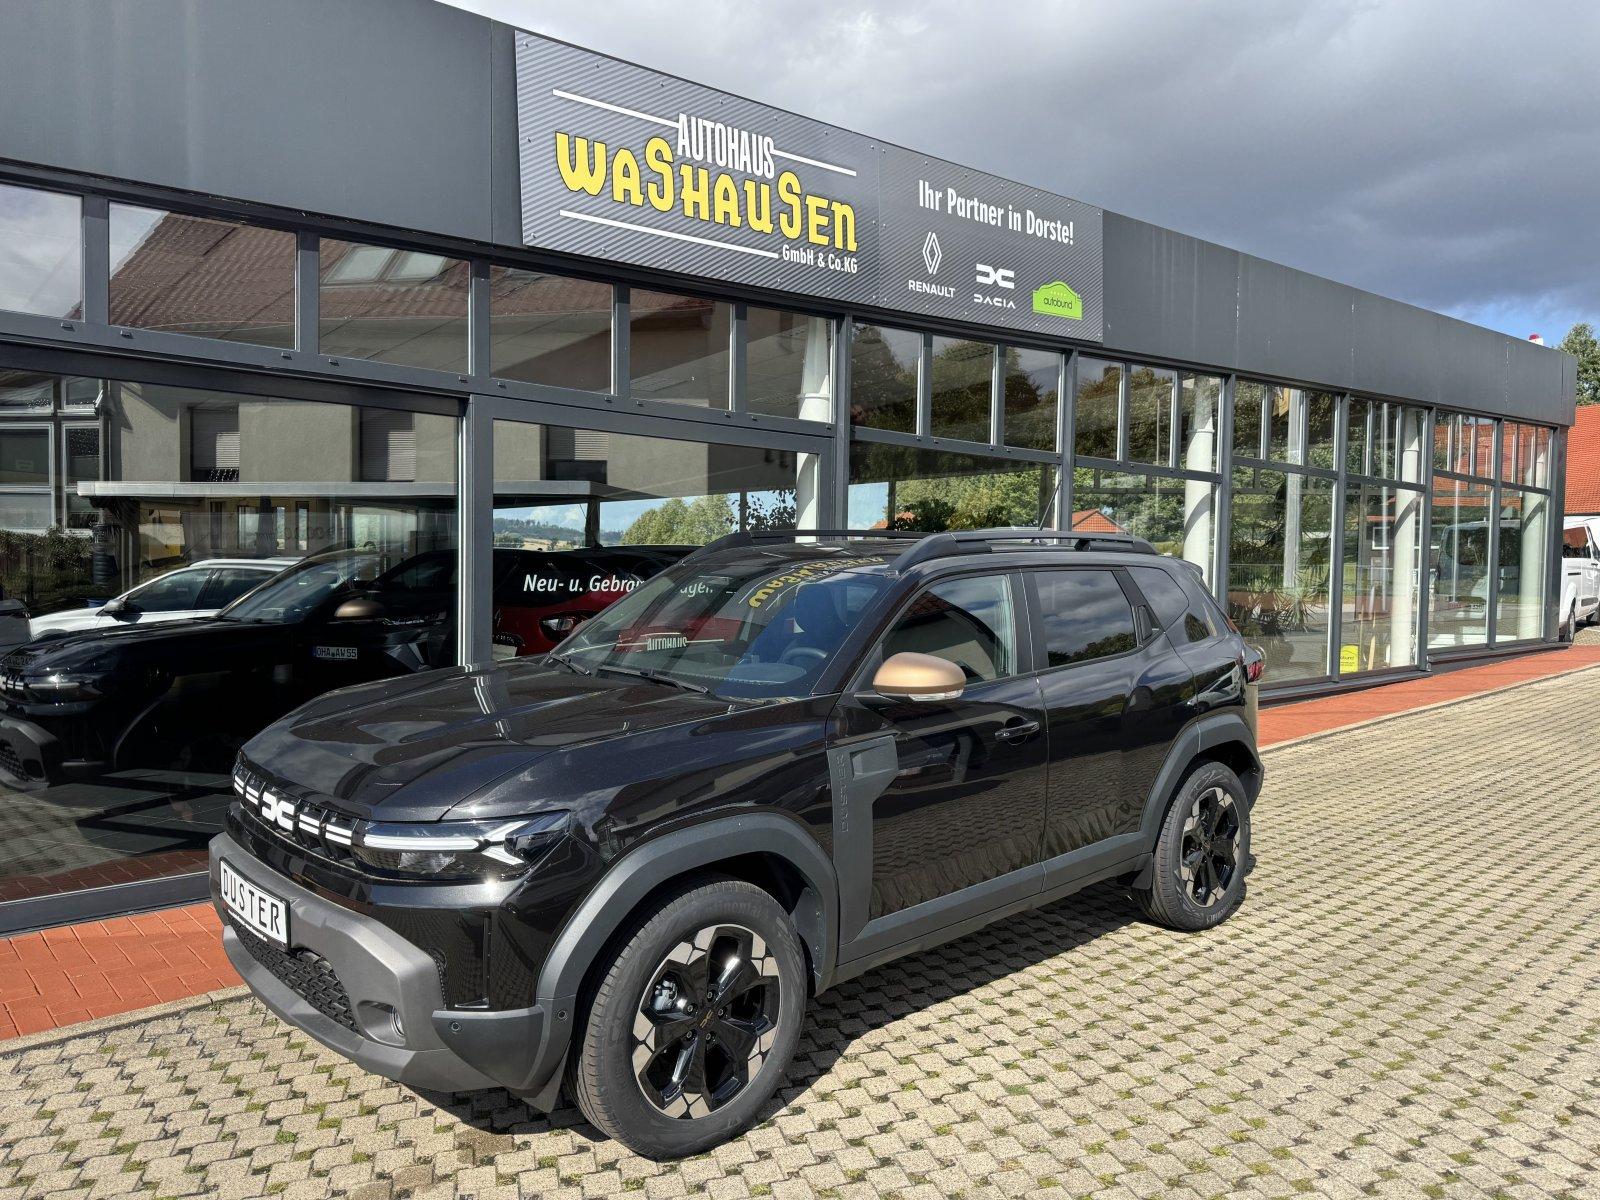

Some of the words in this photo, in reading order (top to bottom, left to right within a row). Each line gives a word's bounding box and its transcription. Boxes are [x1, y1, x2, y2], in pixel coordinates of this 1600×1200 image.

[677, 113, 776, 179] AUTOHAUS
[918, 179, 943, 211] Ihr
[947, 187, 1005, 227] Partner
[1008, 204, 1022, 232] in
[1026, 209, 1074, 246] Dorste!
[782, 244, 814, 266] GmbH
[817, 252, 826, 268] &
[828, 253, 858, 274] Co.KG
[908, 279, 956, 299] RENAULT
[973, 293, 1016, 310] DACIA
[1043, 296, 1073, 311] autobund
[523, 574, 564, 592] Neu-
[569, 579, 583, 592] u.
[223, 868, 281, 935] DUSTER
